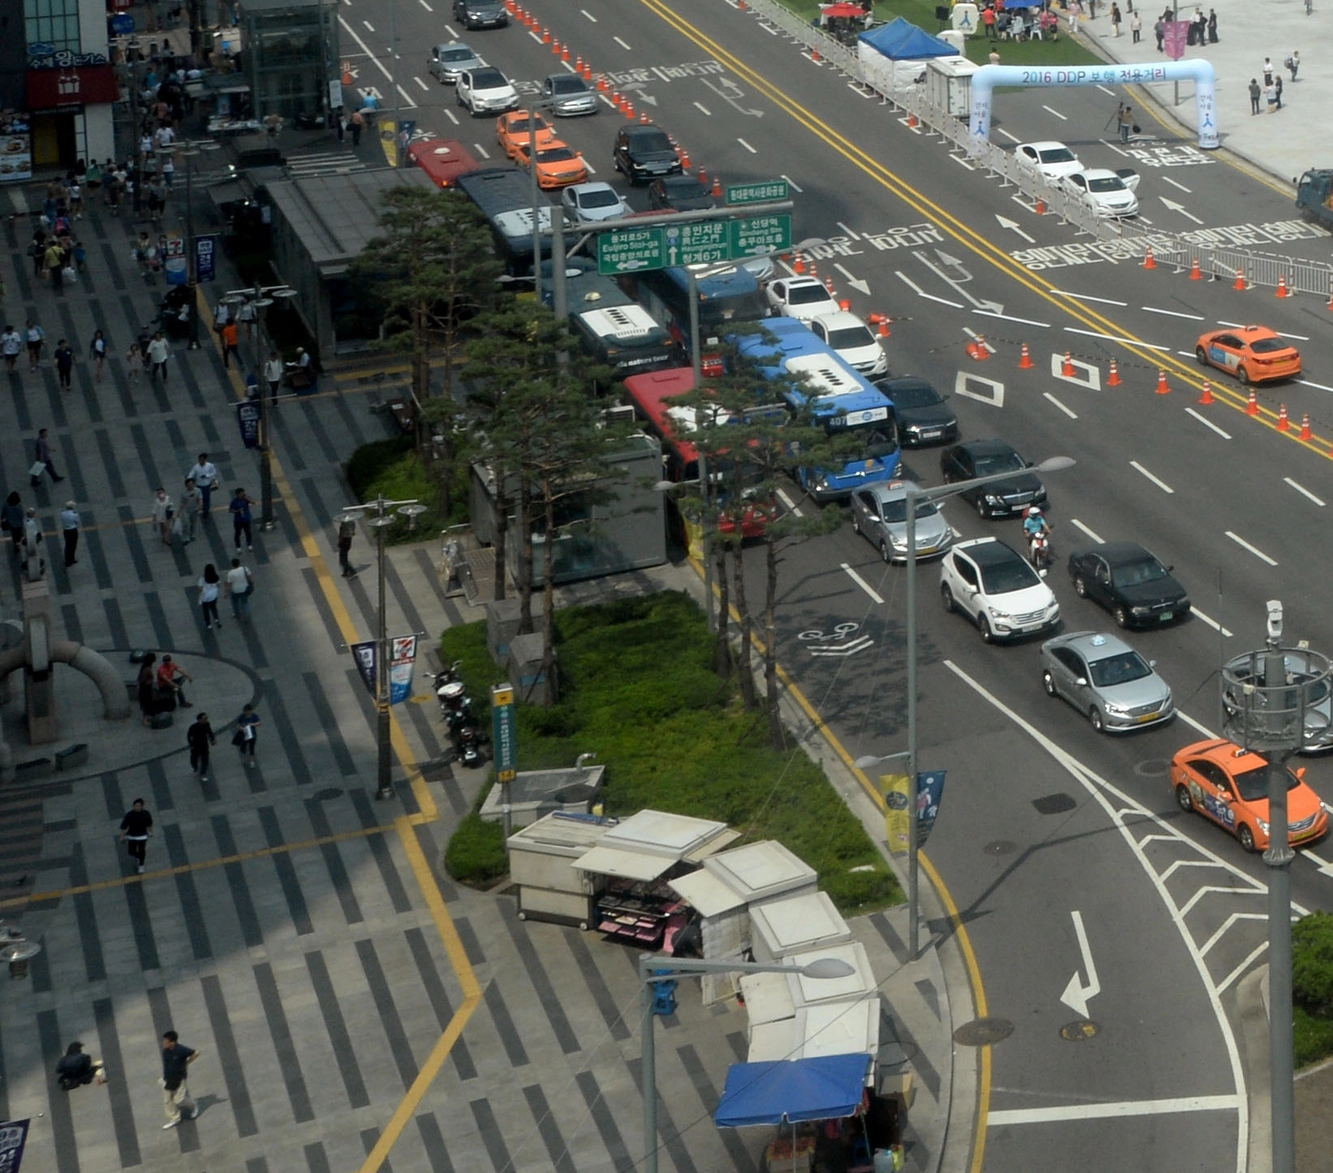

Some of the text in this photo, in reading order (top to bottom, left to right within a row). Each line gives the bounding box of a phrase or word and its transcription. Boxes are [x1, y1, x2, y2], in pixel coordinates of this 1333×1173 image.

[1022, 67, 1167, 84] 2016 DDP 보행 전용거리
[752, 218, 778, 228] 신당역
[682, 252, 721, 264] 청계6가
